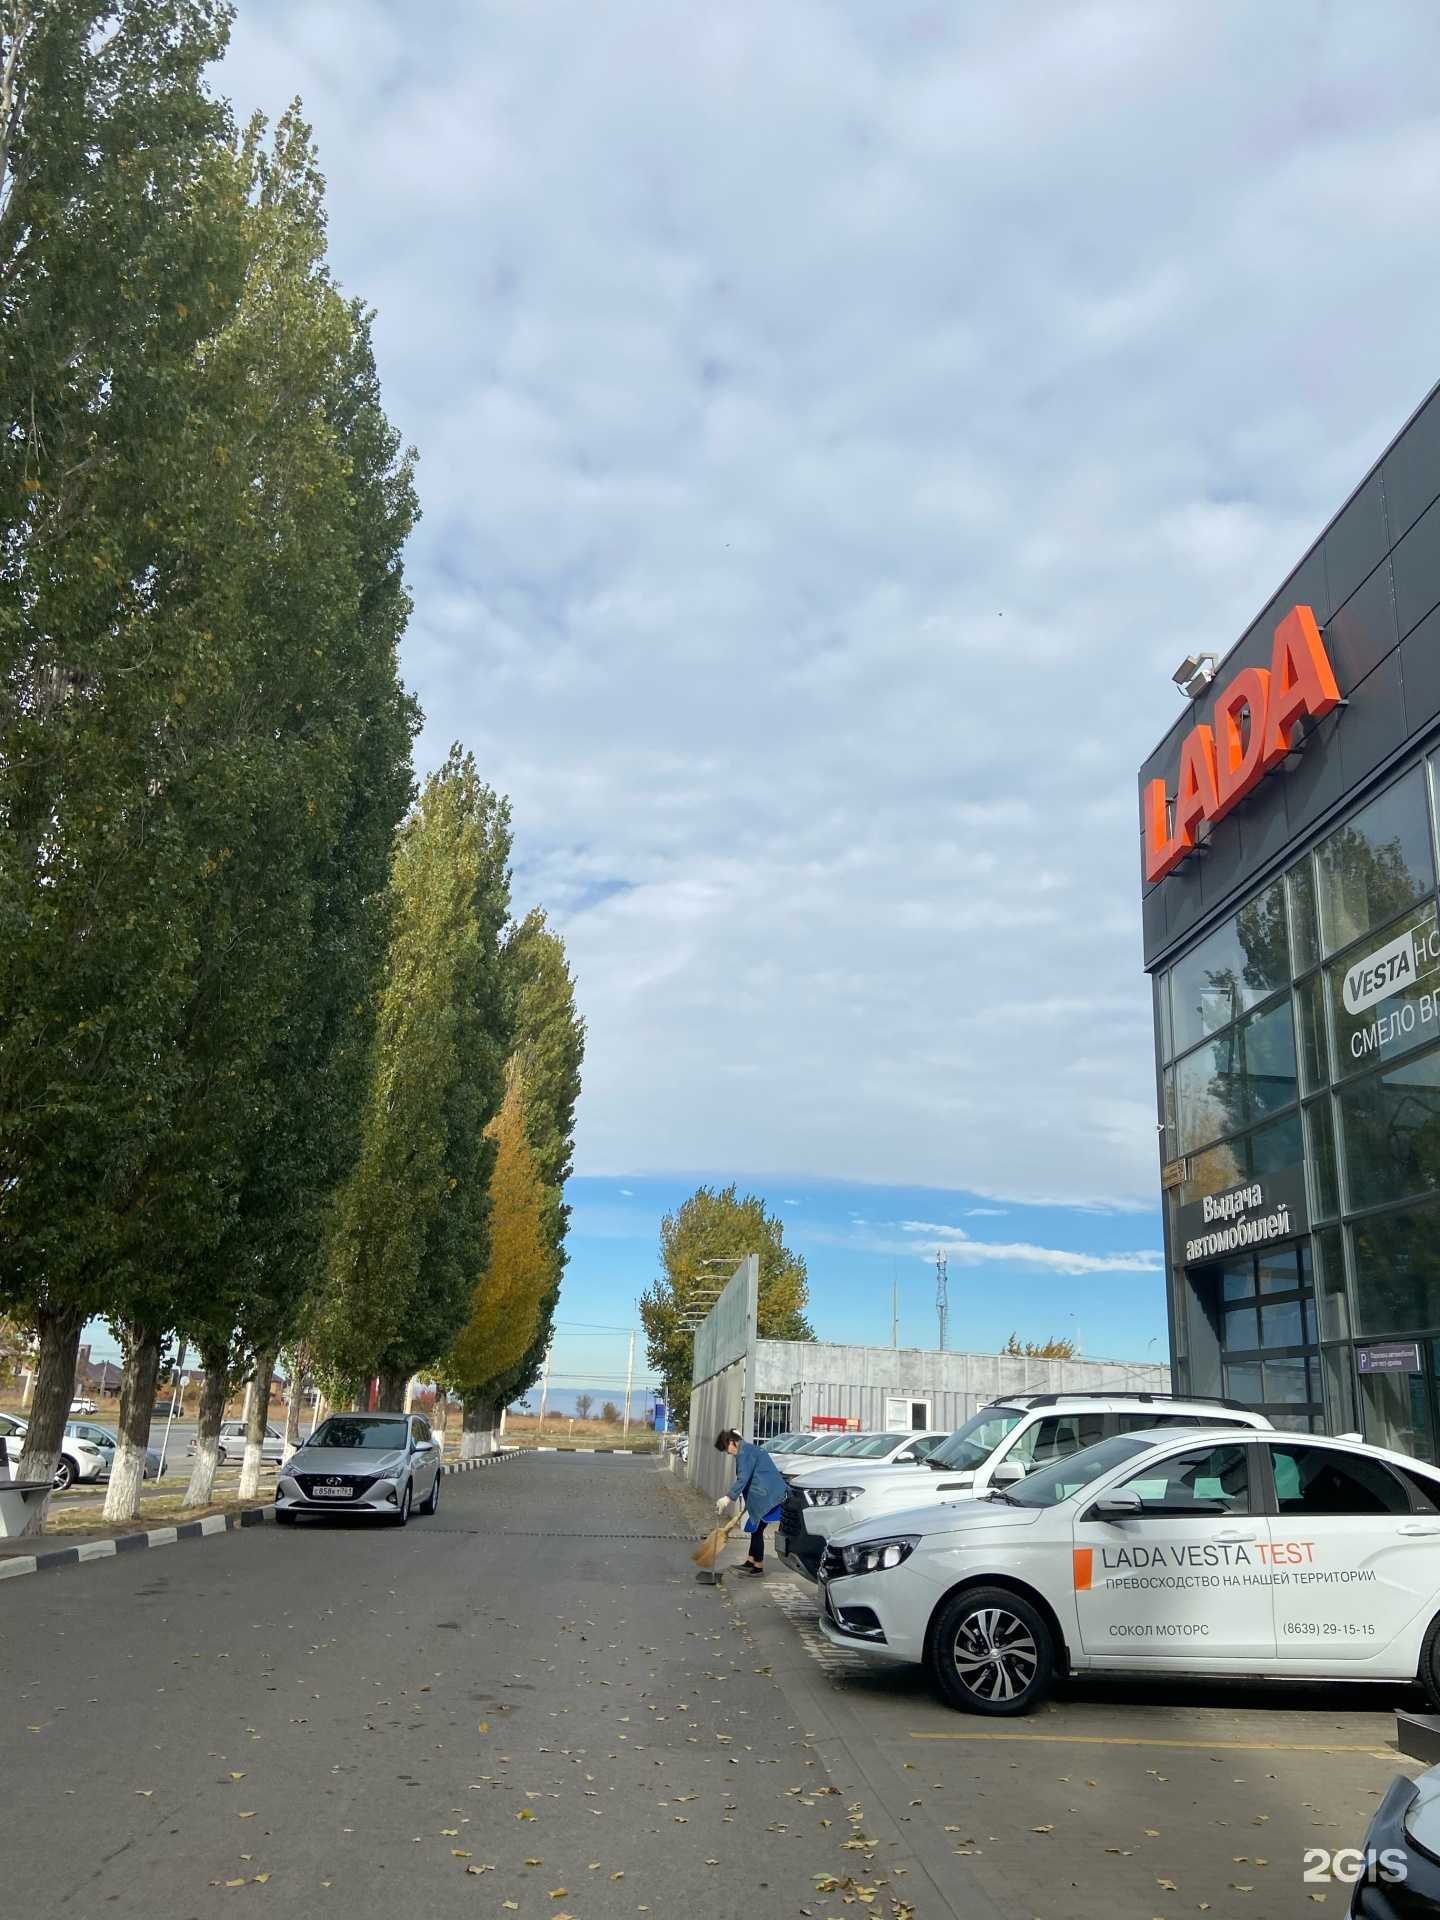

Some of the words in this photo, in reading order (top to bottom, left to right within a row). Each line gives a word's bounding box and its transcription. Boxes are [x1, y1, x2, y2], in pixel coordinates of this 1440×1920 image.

[1144, 605, 1341, 882] LADA
[1350, 950, 1410, 1002] VESTA
[1351, 1004, 1415, 1058] СМЕЛО
[1203, 1184, 1263, 1223] Выдача
[1186, 1203, 1290, 1261] автомобилей
[1102, 1547, 1167, 1568] LADA
[1170, 1544, 1251, 1566] VESTA
[1254, 1542, 1315, 1565] TEST
[1106, 1575, 1220, 1589] ПРЕВОСХОДСТВО
[1223, 1575, 1241, 1587] НА
[1243, 1571, 1290, 1586] НАШЕЙ
[1292, 1569, 1377, 1584] ТЕРРИТОРИИ
[1109, 1625, 1153, 1636] СОКОЛ
[1156, 1624, 1209, 1636] МОТОРС
[1283, 1622, 1320, 1636] (8639)
[1323, 1623, 1375, 1635] 29-15-15
